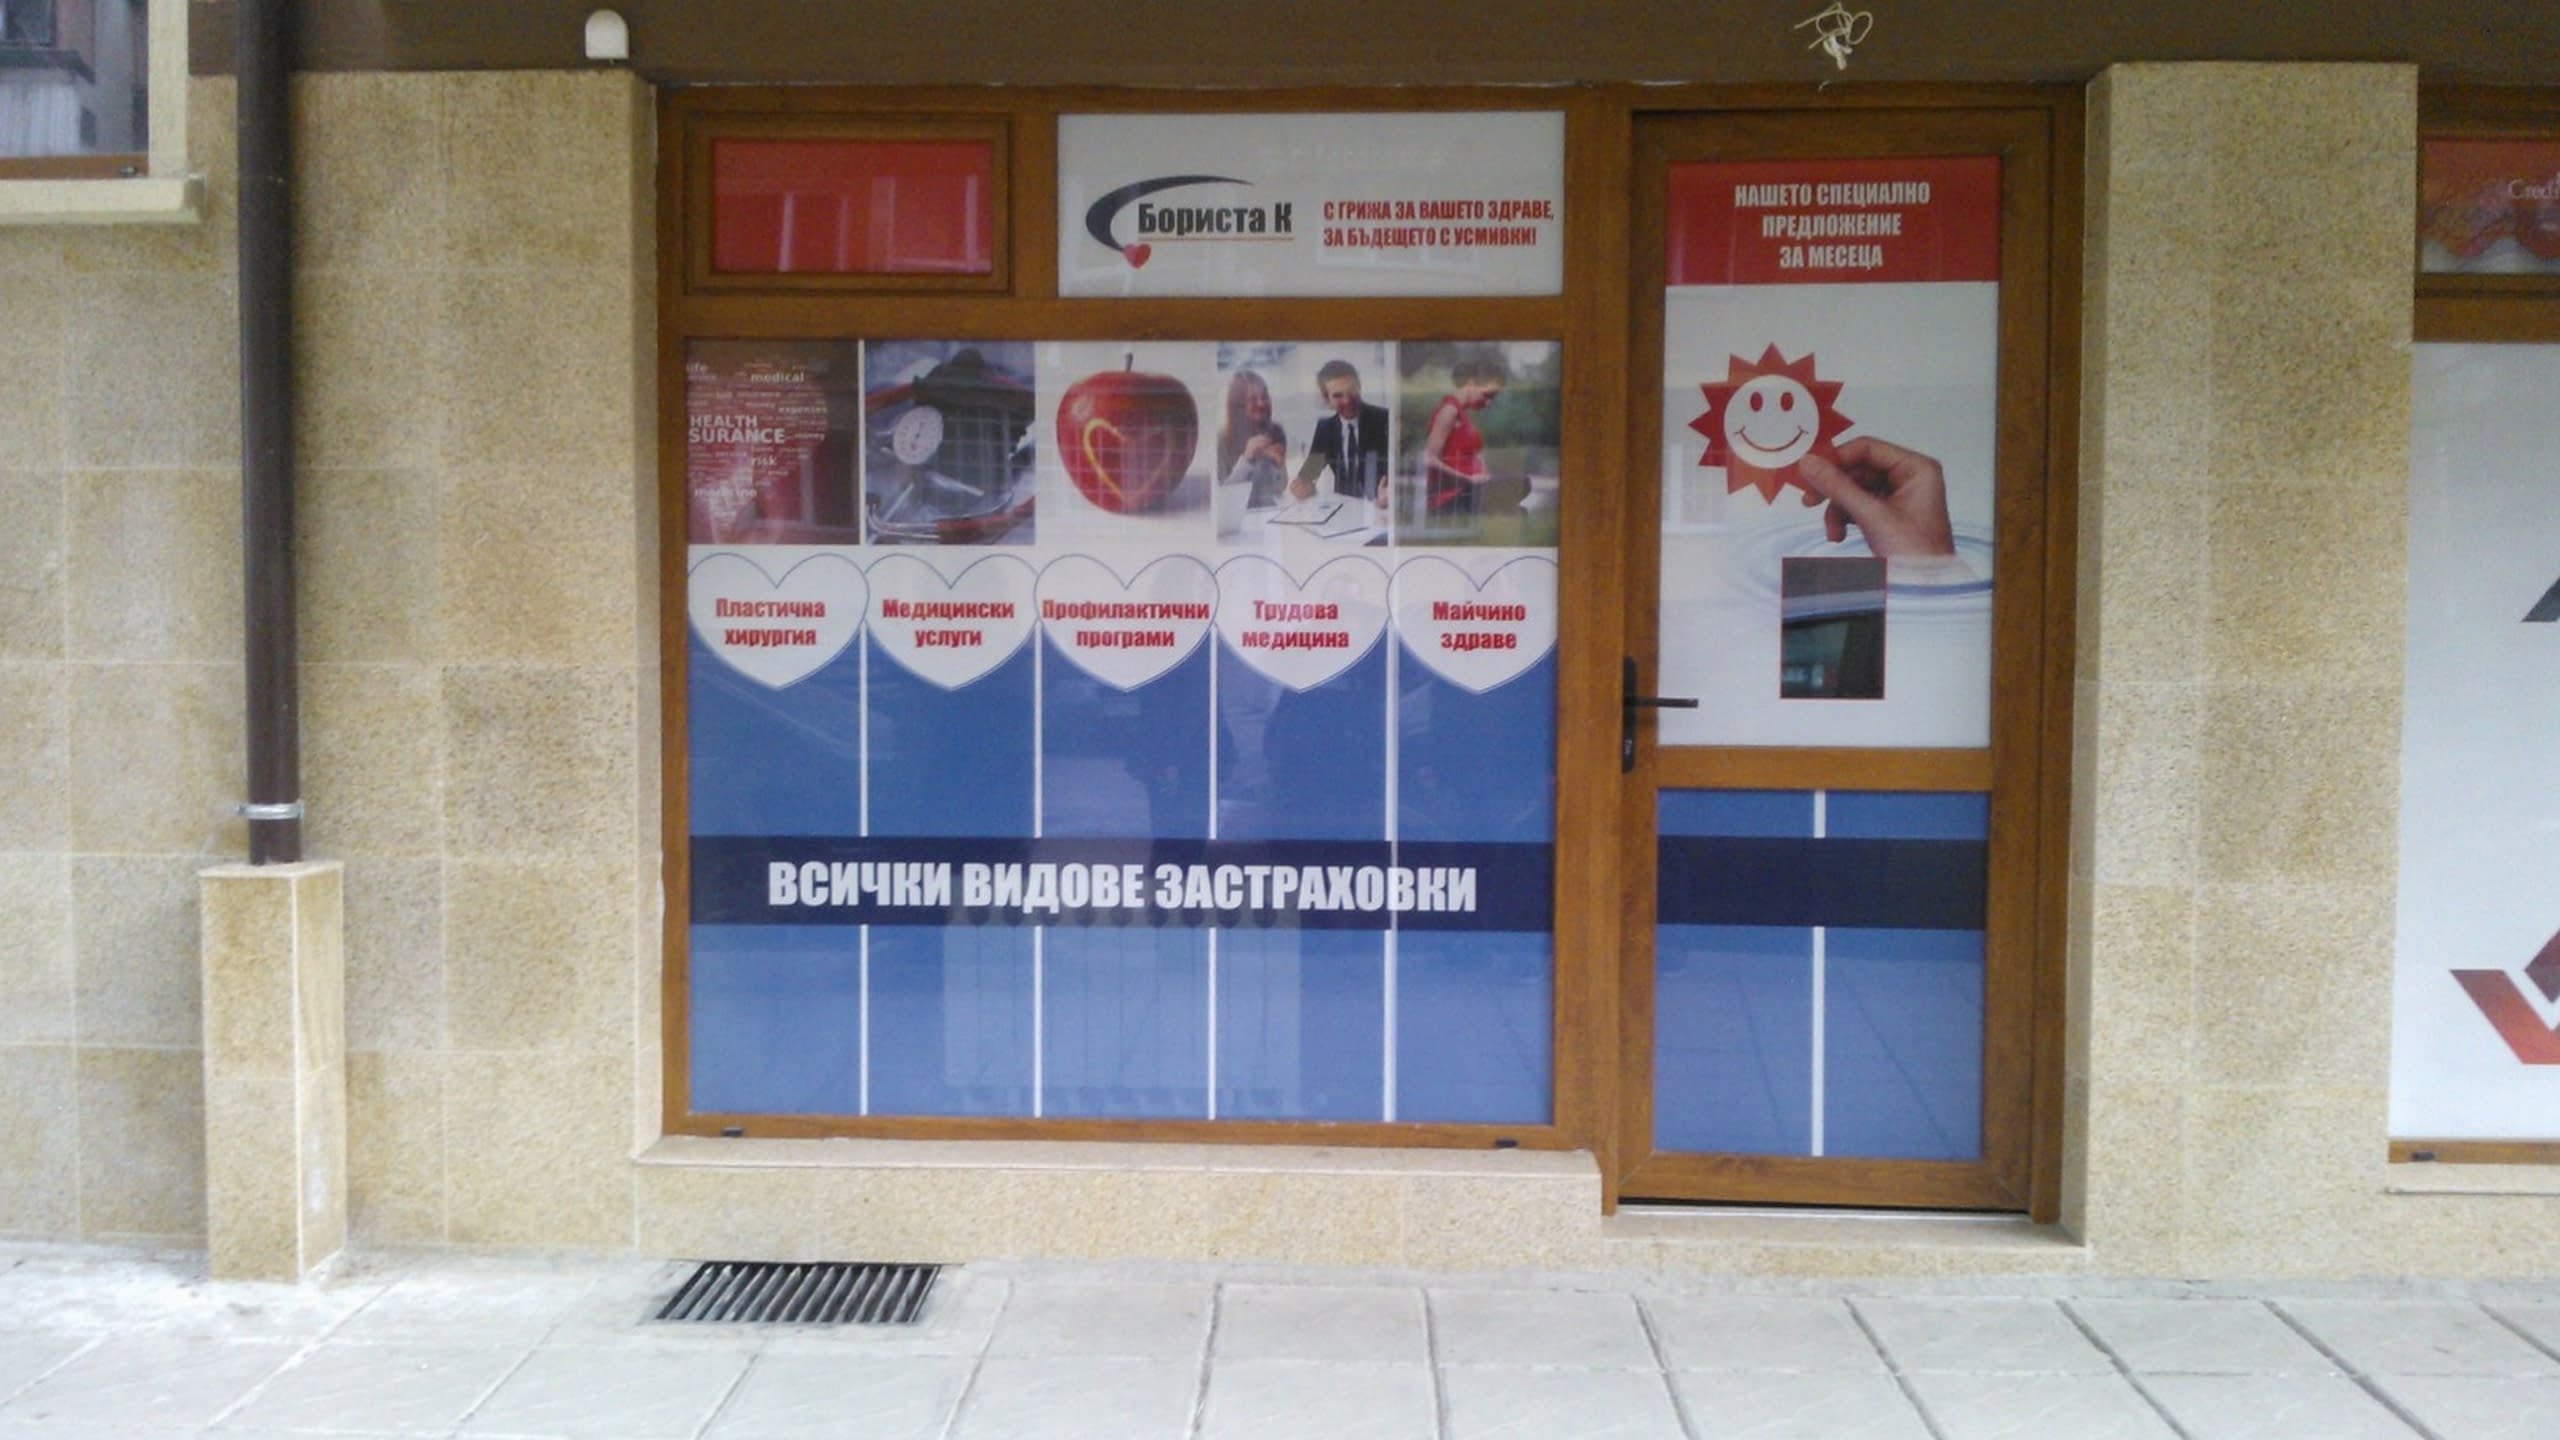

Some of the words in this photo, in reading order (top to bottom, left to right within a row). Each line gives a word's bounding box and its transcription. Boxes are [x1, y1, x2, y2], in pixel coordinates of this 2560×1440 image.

[1734, 183, 1813, 207] НАШЕТО
[1815, 181, 1931, 207] СПЕЦИАЛНО
[1138, 202, 1264, 236] Бориста
[1275, 203, 1293, 233] К
[1323, 201, 1335, 220] С
[1338, 201, 1391, 220] ГРИЖА
[1395, 201, 1416, 220] ЗА
[1419, 201, 1484, 220] ВАШЕТО
[1488, 201, 1554, 222] ЗДРАВЕ,
[1761, 213, 1902, 240] ПРЕДЛОЖЕНИЕ
[1323, 228, 1344, 247] ЗА
[1346, 227, 1436, 248] БЪДЕЩЕТО
[1440, 227, 1451, 246] С
[1454, 227, 1537, 246] УСМИВКИ!
[1779, 246, 1804, 269] ЗА
[1808, 245, 1883, 270] МЕСЕЦА
[750, 372, 805, 384] medical
[690, 414, 758, 429] HEALTH
[751, 455, 778, 467] risk
[716, 599, 826, 619] Пластична
[883, 600, 1015, 622] Медицински
[1042, 600, 1210, 623] Профилактични
[1254, 601, 1339, 623] Трудова
[1433, 600, 1526, 621] Майчино
[724, 628, 817, 648] хирургия
[914, 629, 983, 648] услуги
[1077, 630, 1175, 650] програми
[1242, 629, 1350, 650] медицина
[1441, 633, 1517, 652] здраве
[768, 861, 952, 907] ВСИЧКИ
[962, 863, 1145, 914] ВИДОВЕ
[1154, 865, 1478, 912] ЗАСТРАХОВКИ
